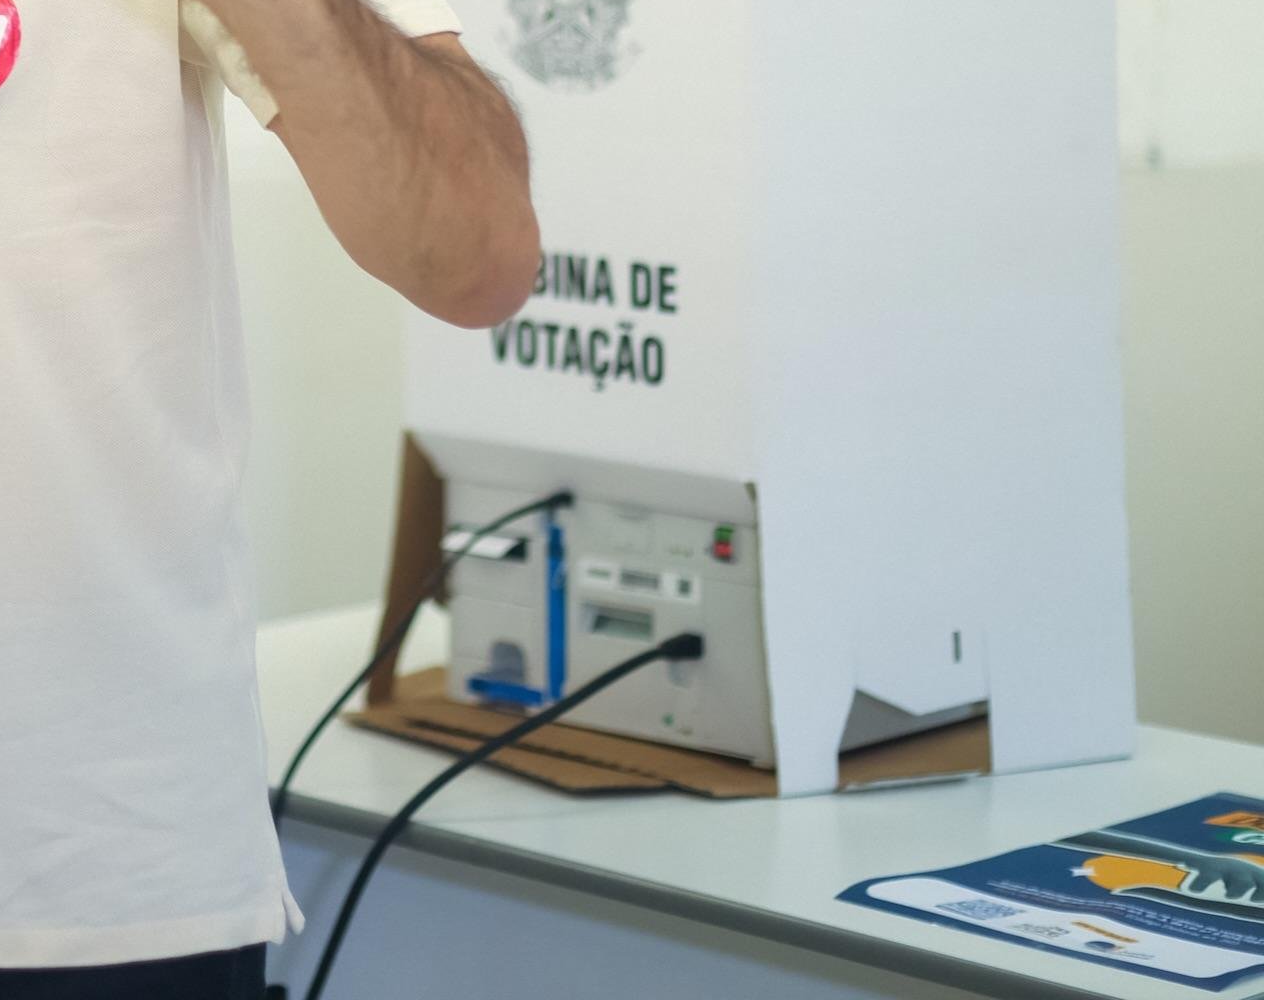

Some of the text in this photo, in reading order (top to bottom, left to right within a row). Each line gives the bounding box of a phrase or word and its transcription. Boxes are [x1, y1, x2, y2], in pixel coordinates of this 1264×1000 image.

[532, 250, 678, 314] BINA DE
[491, 319, 665, 393] VOTAÇÃO
